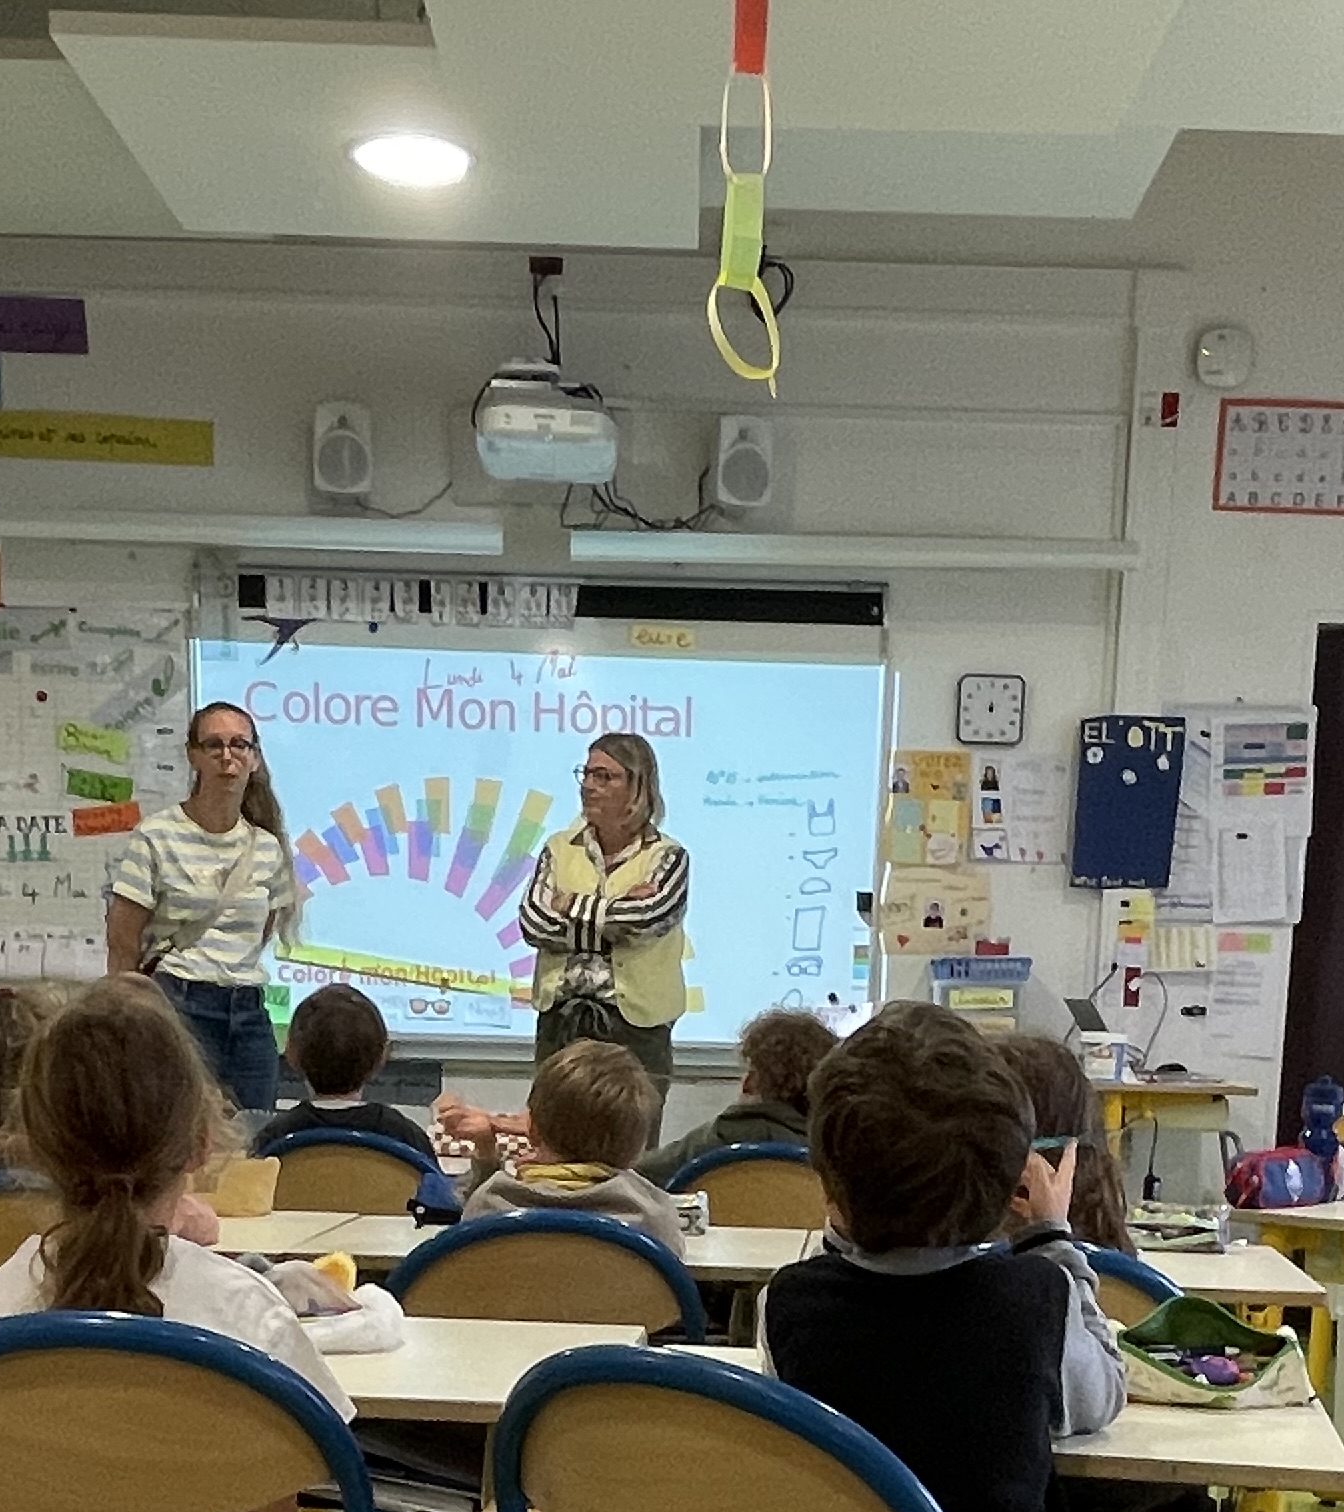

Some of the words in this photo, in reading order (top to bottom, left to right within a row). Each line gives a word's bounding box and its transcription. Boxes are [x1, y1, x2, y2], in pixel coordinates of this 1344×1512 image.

[509, 658, 524, 686] 4
[244, 680, 400, 727] Colore
[415, 686, 517, 733] Mon
[533, 689, 694, 739] Hôpital
[16, 814, 69, 834] DATE
[21, 882, 40, 905] 4
